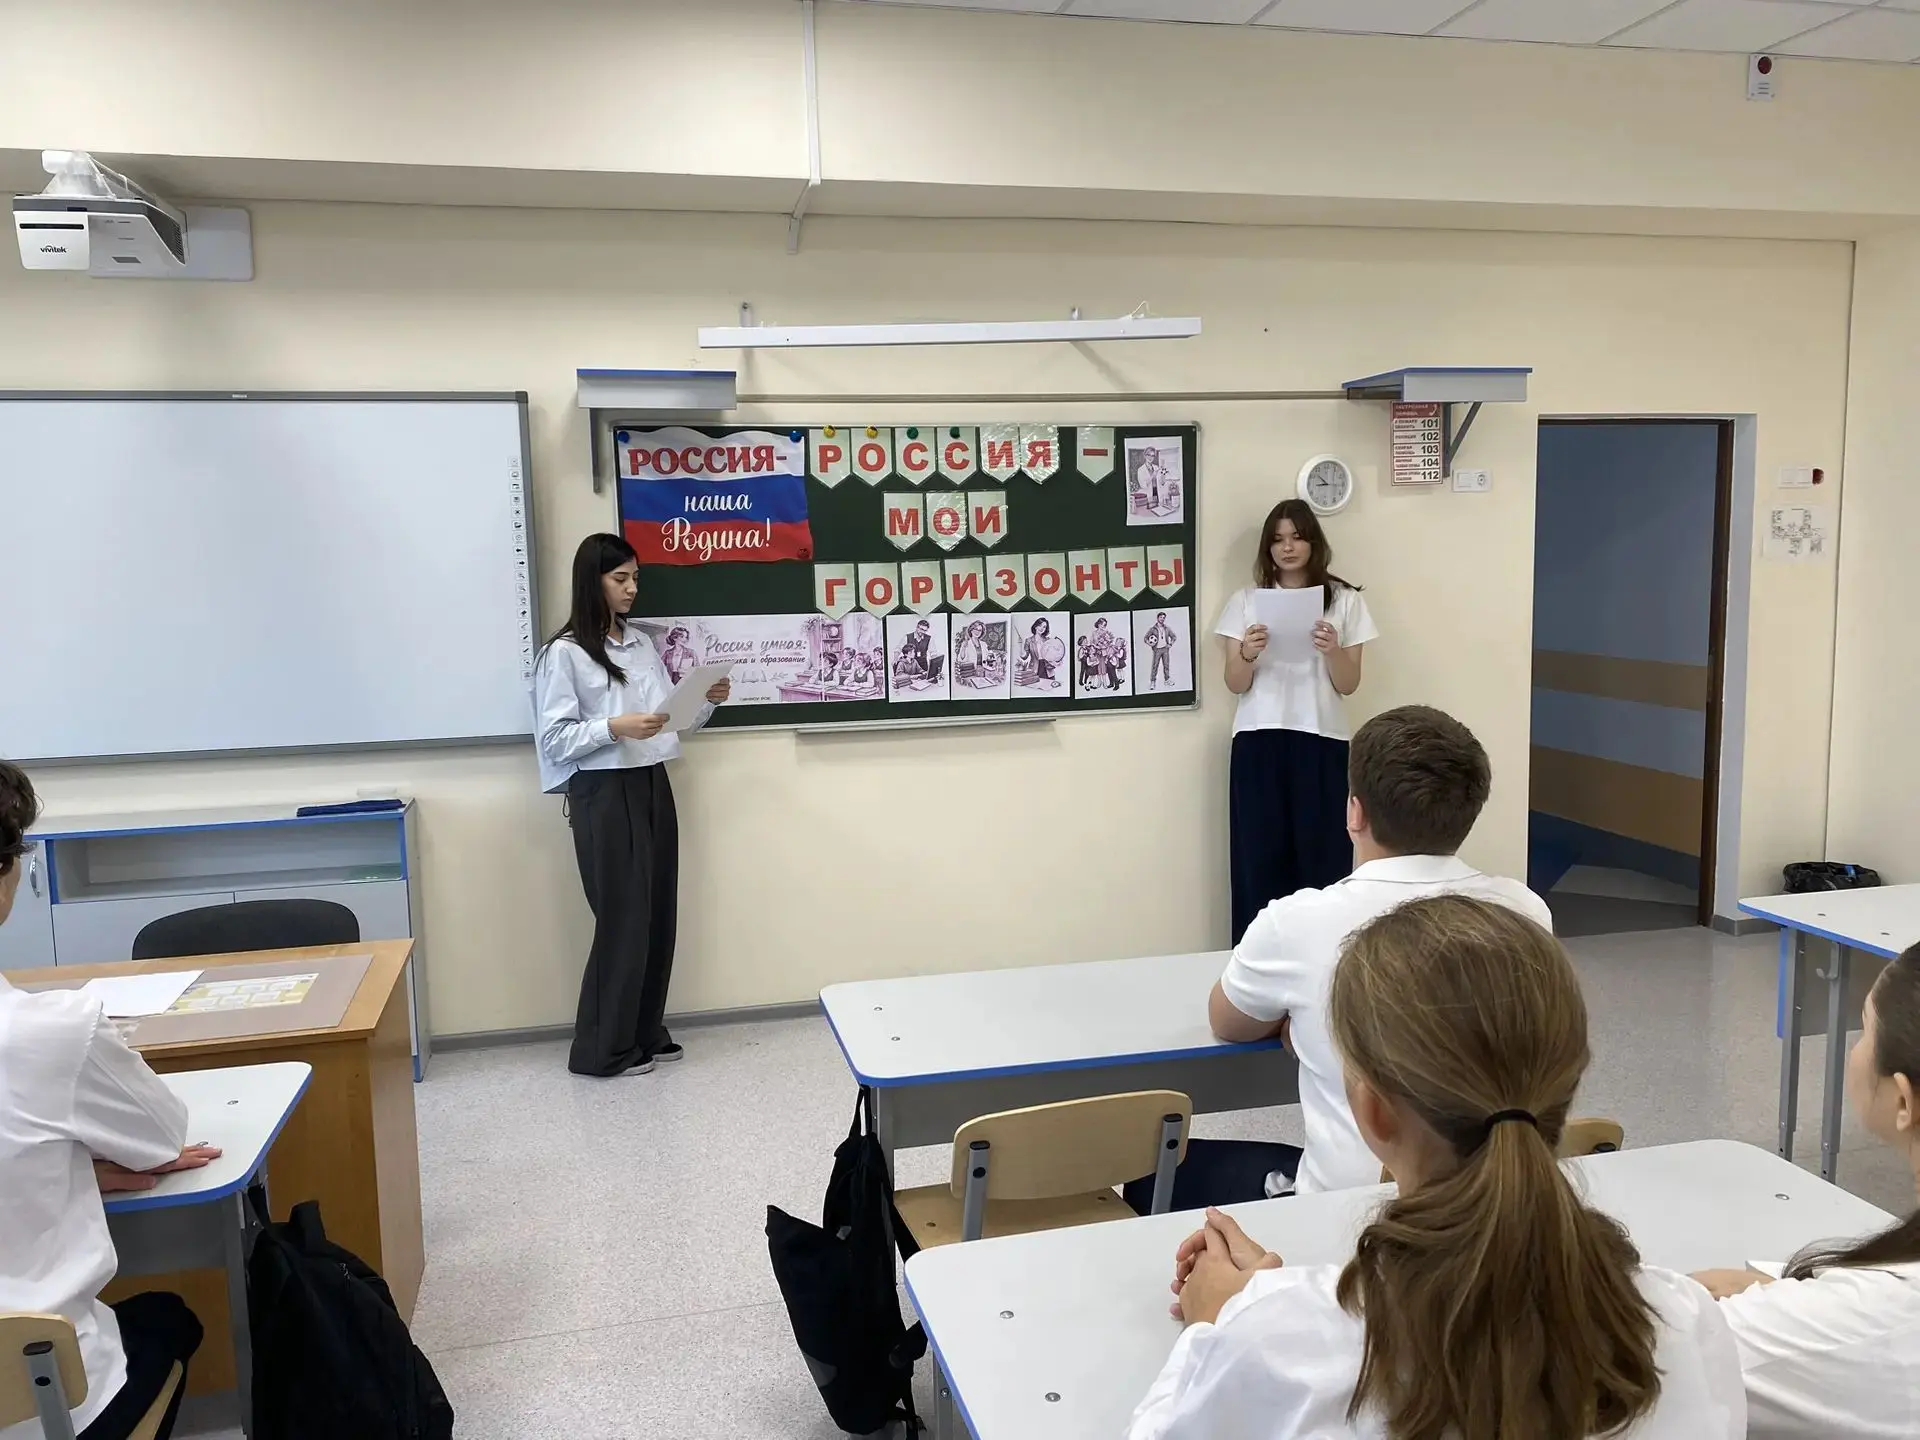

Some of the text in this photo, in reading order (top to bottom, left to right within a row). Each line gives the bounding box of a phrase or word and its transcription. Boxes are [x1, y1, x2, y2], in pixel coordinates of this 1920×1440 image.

[40, 245, 67, 253] vivitek
[1421, 419, 1439, 428] 101
[1421, 432, 1439, 441] 102
[818, 440, 1052, 473] РОССИЯ
[1421, 445, 1439, 454] 103
[627, 445, 787, 476] РОССИЯ-
[1421, 458, 1439, 467] 104
[1421, 471, 1439, 480] 112
[684, 492, 753, 512] наша
[888, 505, 1001, 536] МОИ
[660, 516, 771, 561] Родина!
[824, 558, 1183, 606] ГОРИЗОНТЫ
[705, 634, 807, 656] Россия умная:
[760, 654, 806, 666] образование
